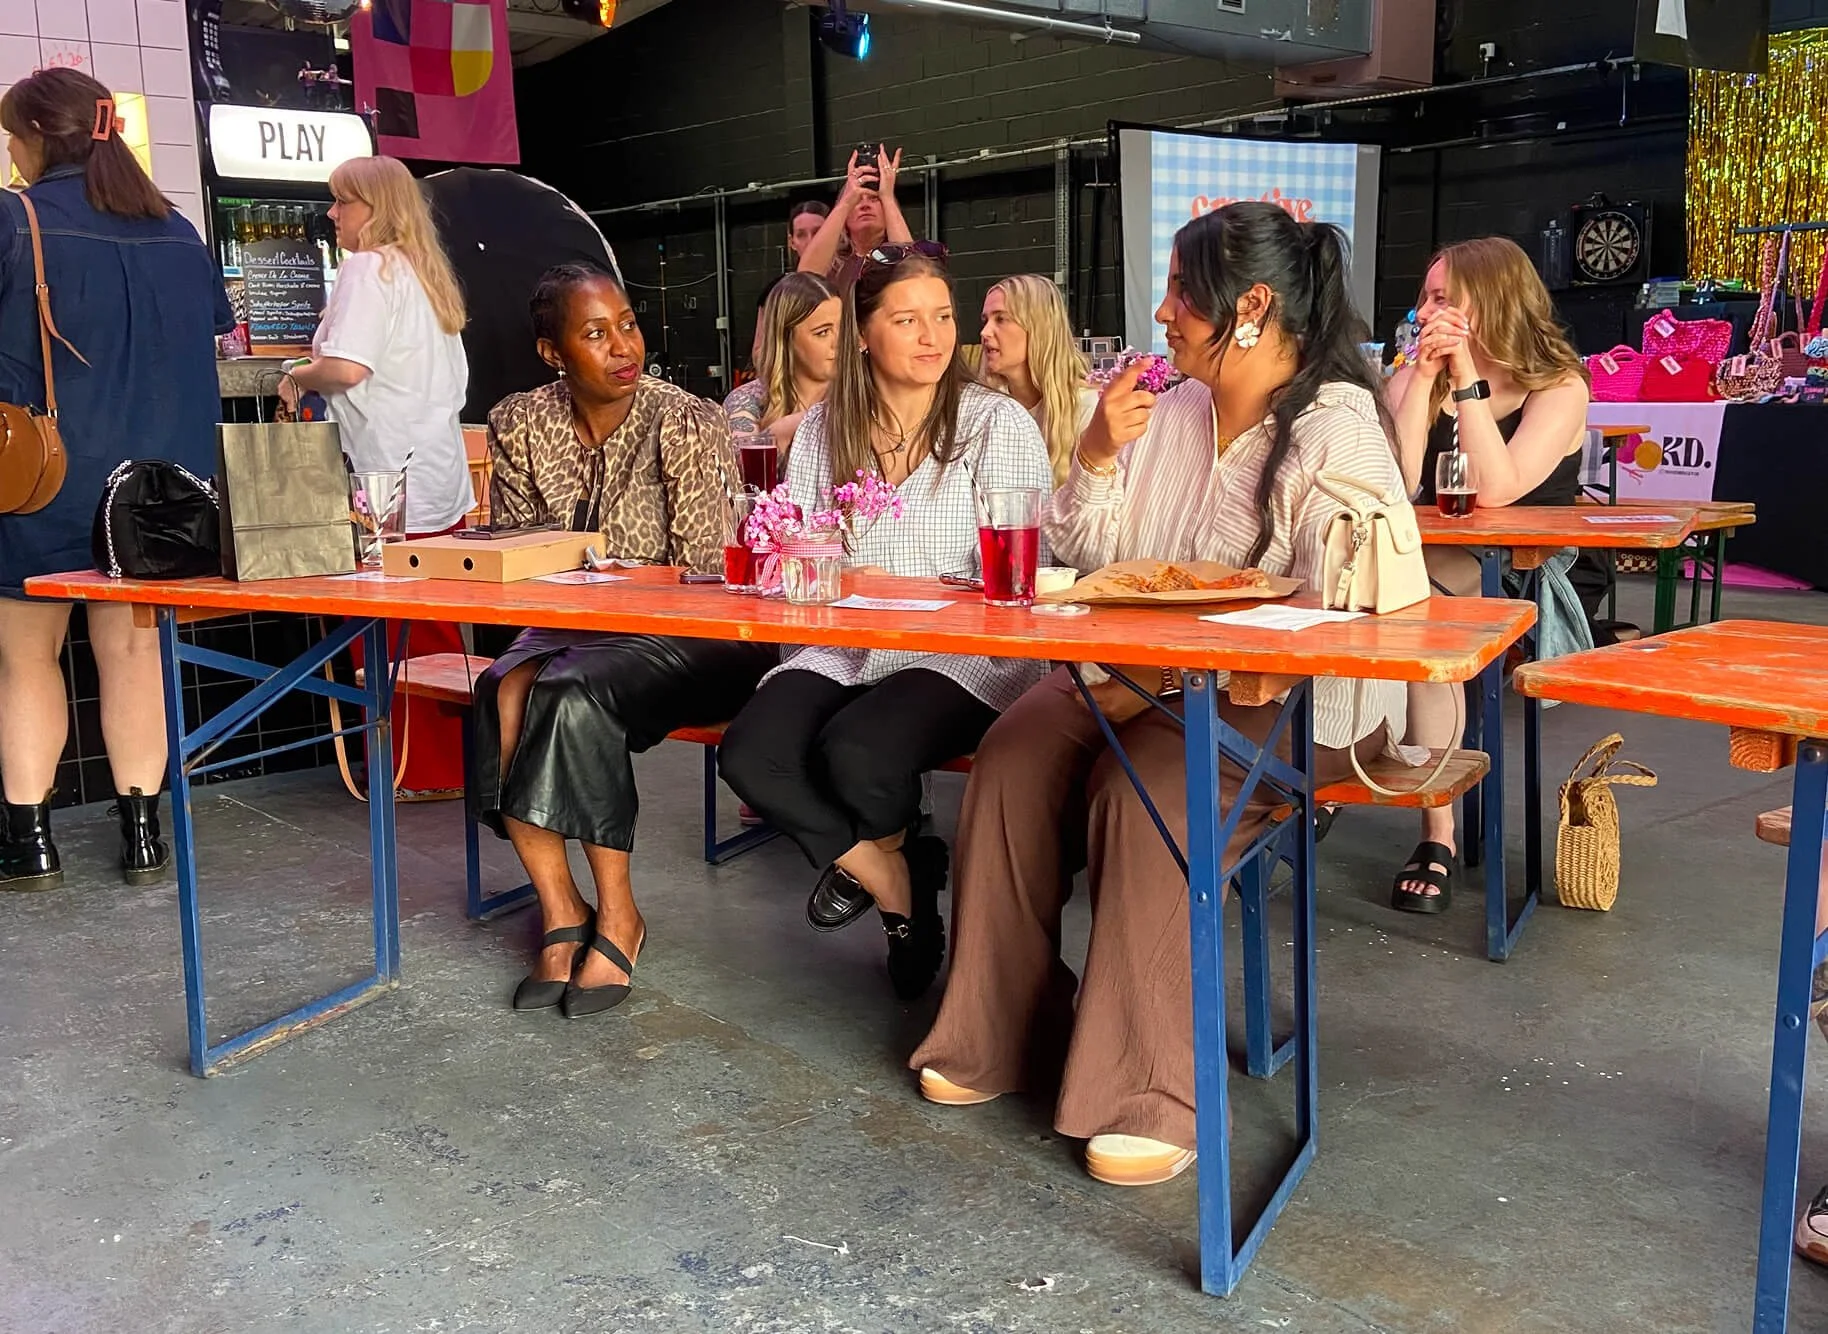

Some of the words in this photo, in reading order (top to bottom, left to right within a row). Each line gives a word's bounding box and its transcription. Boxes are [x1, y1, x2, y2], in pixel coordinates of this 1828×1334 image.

[258, 120, 326, 162] PLAY
[243, 251, 279, 265] Dessert
[280, 251, 315, 265] Cocktails
